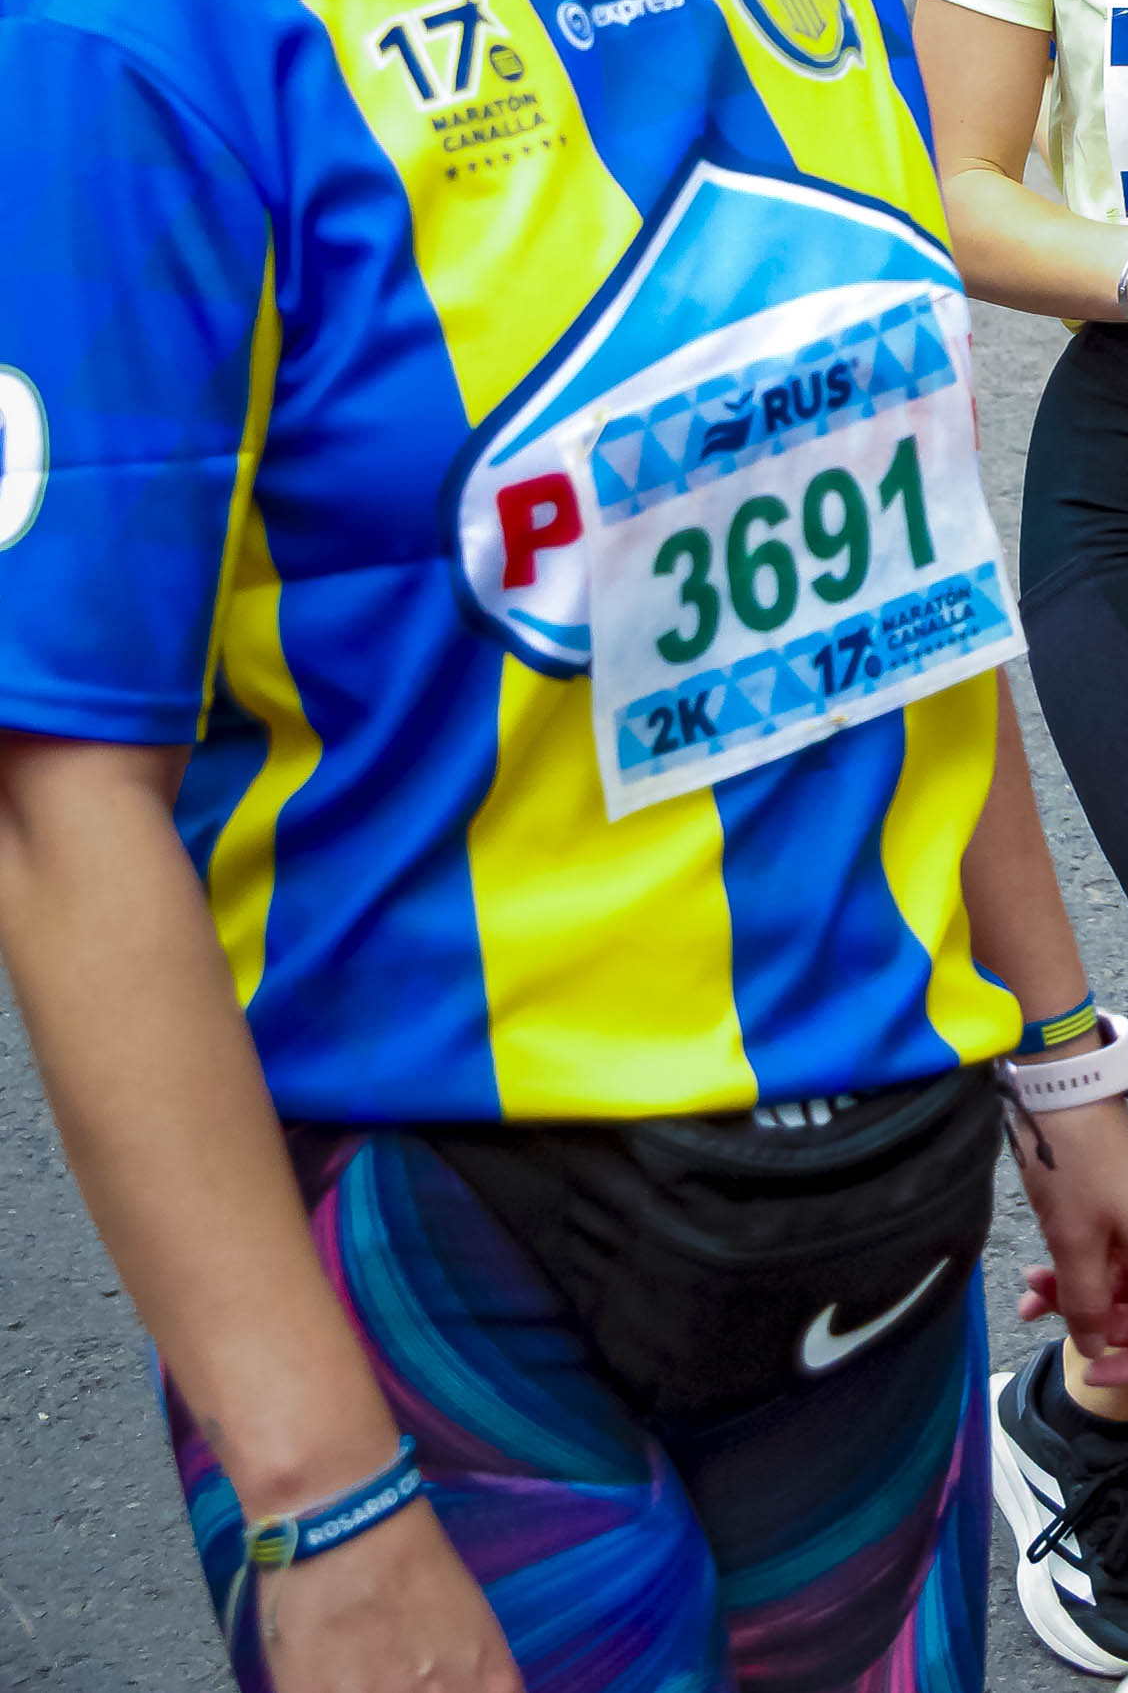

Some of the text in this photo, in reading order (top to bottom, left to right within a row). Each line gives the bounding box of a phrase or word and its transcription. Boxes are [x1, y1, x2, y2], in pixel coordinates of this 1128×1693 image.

[443, 111, 547, 153] CANALLA
[761, 363, 853, 435] RUS
[652, 434, 937, 667] 3691
[881, 586, 972, 633] MARATÓN
[887, 603, 975, 651] CANALLA
[813, 627, 873, 697] 17
[647, 689, 717, 756] 2K
